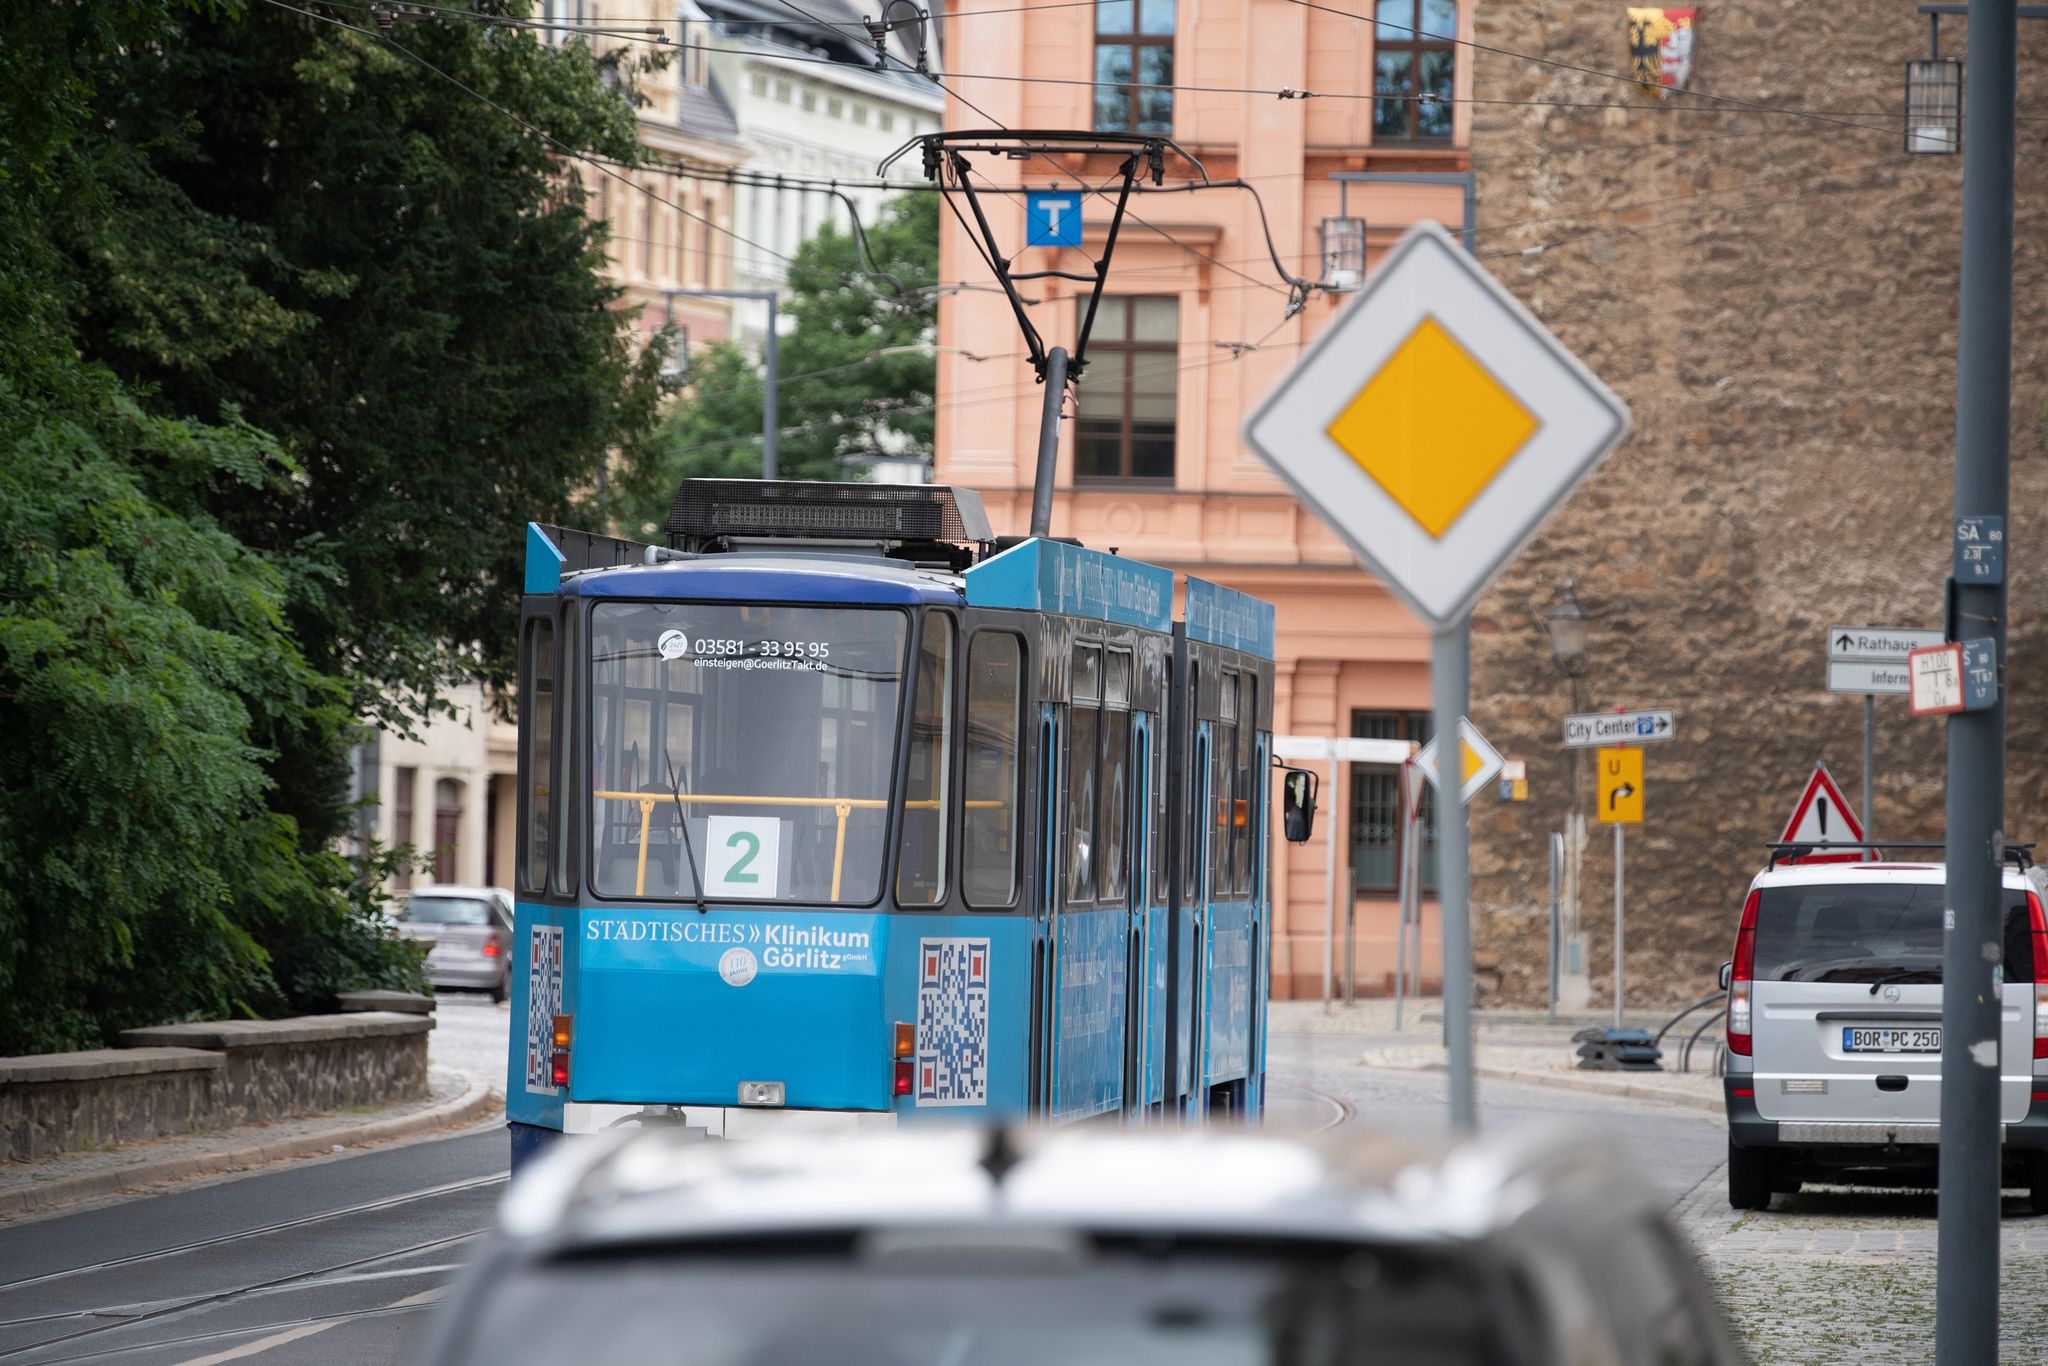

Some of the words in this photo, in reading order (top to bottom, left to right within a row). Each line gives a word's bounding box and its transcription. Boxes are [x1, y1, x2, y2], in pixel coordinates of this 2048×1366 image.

[1957, 525, 1980, 541] SA
[695, 639, 744, 655] 03581
[759, 640, 780, 656] 33
[783, 641, 805, 657] 95
[809, 642, 830, 658] 95
[1858, 635, 1919, 651] Rathaus
[693, 657, 828, 671] einsteigen@GoerlitzTakt.de
[1568, 721, 1592, 742] City
[1595, 718, 1636, 736] Center
[1609, 759, 1621, 776] U
[722, 830, 761, 884] 2
[586, 919, 746, 944] STÄDTISCHES
[764, 924, 870, 949] Klinikum
[762, 946, 842, 969] Görlitz
[1854, 1031, 1881, 1047] BOR
[1891, 1031, 1909, 1047] PC
[1912, 1031, 1940, 1048] 250
